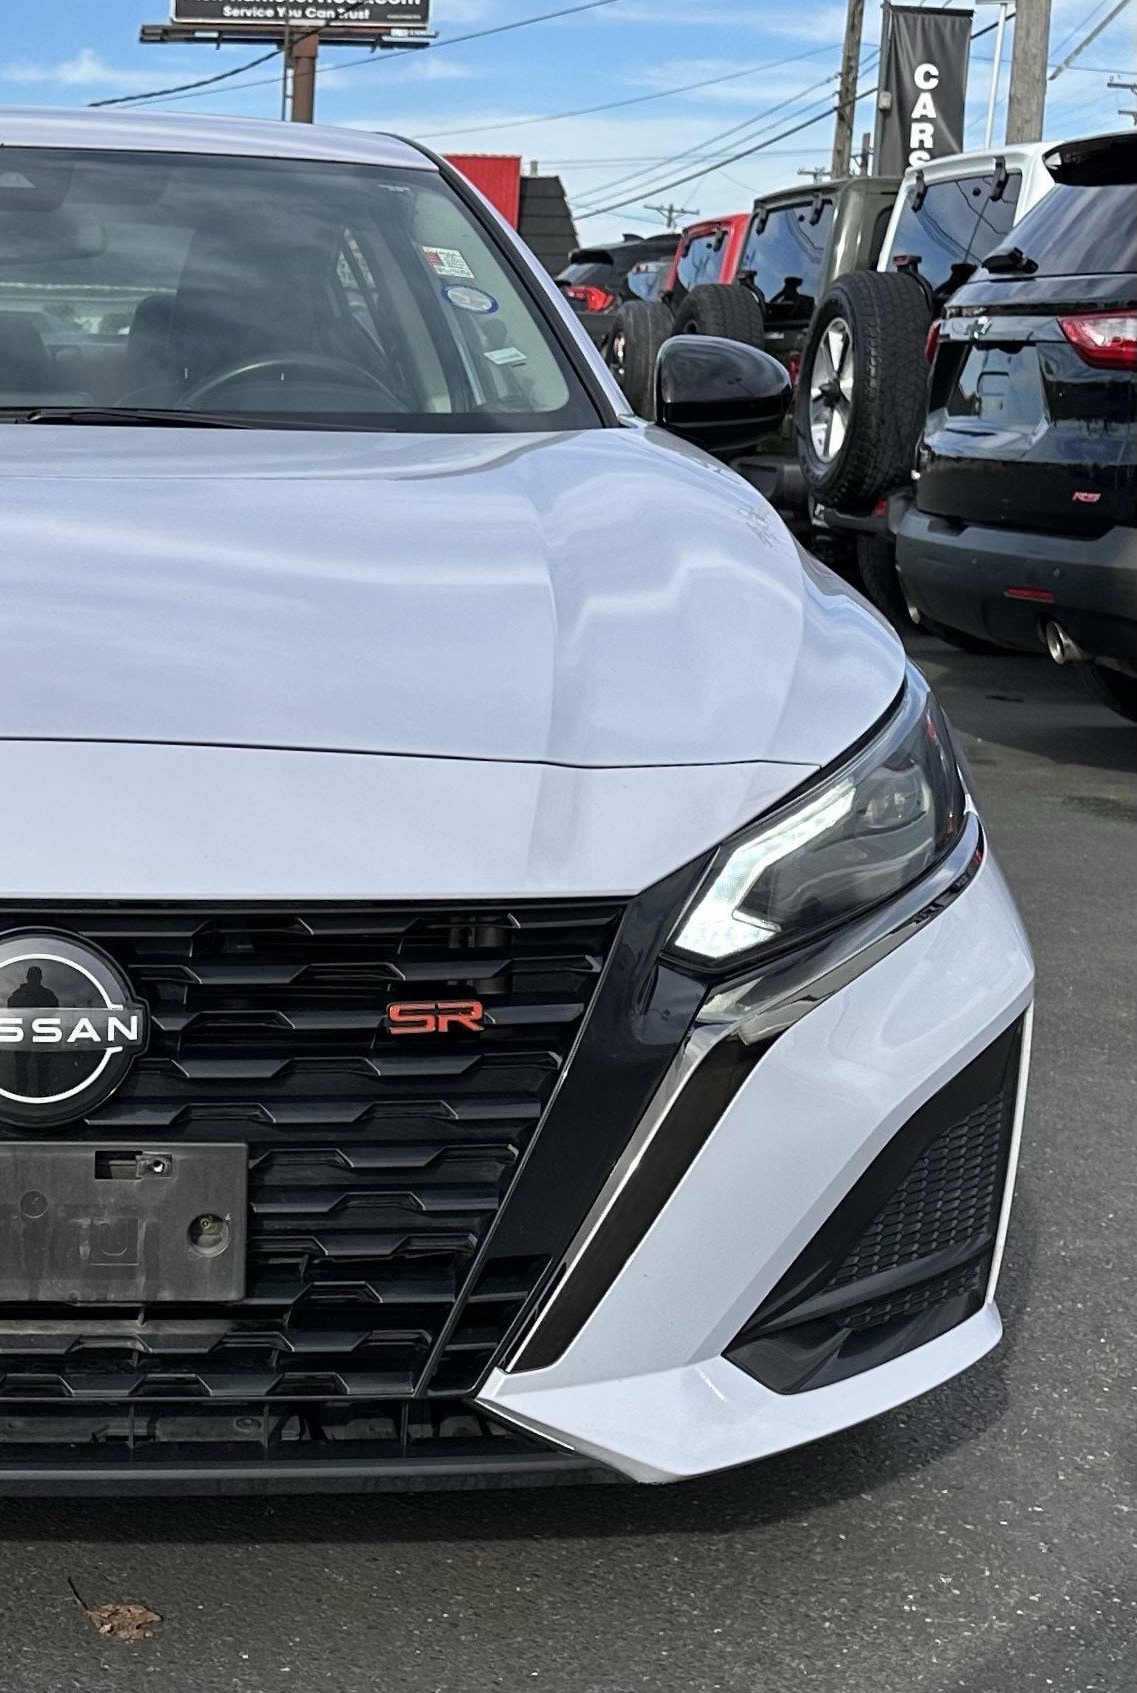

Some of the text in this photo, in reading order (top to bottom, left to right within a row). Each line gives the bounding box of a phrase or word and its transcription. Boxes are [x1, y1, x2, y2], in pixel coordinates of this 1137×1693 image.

[223, 5, 370, 19] Service You Can Trust
[387, 1001, 484, 1034] SR
